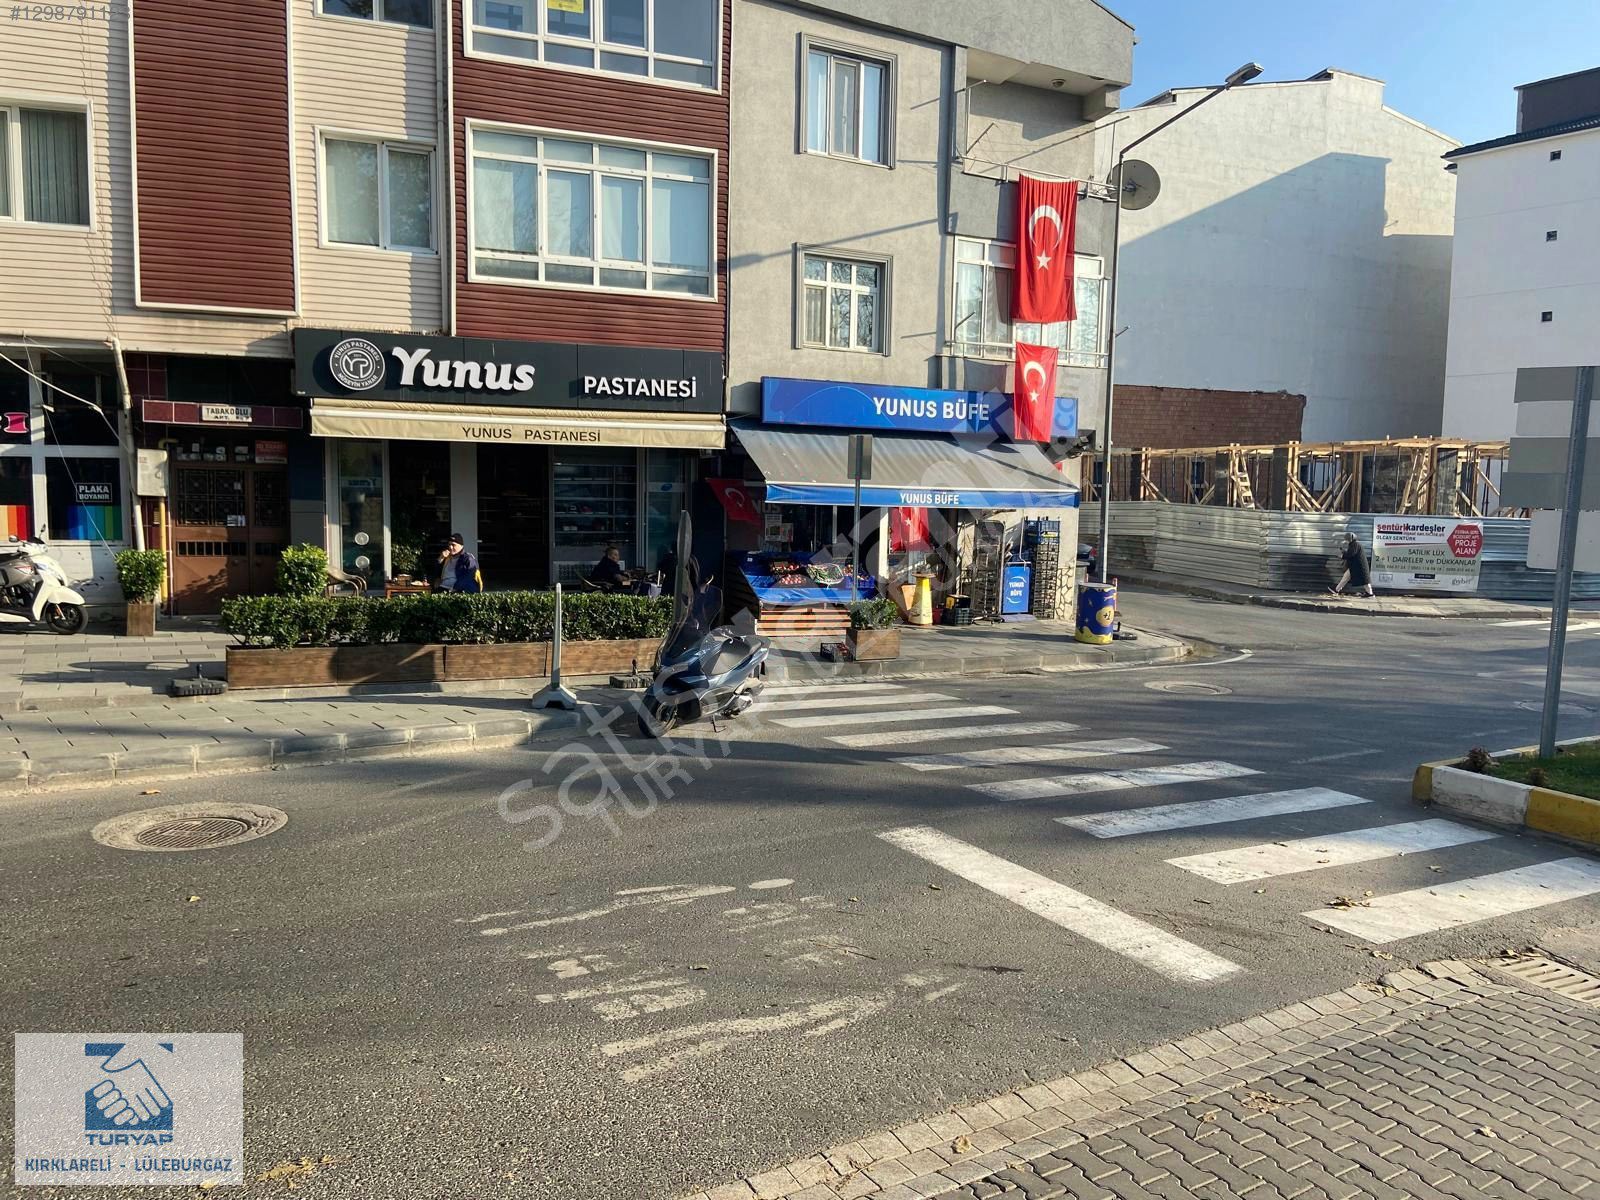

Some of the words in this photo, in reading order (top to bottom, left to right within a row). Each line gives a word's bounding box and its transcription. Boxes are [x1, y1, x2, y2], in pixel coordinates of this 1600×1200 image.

[334, 342, 350, 358] YUNUS
[392, 346, 535, 394] Yunus
[584, 376, 697, 398] PASTANESİ
[873, 396, 937, 419] YUNUS
[943, 398, 990, 421] BÜFE
[462, 426, 512, 440] YUNUS
[524, 428, 601, 443] PASTANESİ
[79, 485, 109, 493] PLAKA
[900, 493, 933, 505] YUNUS
[935, 493, 960, 505] BÜFE
[1455, 547, 1476, 555] ALANI
